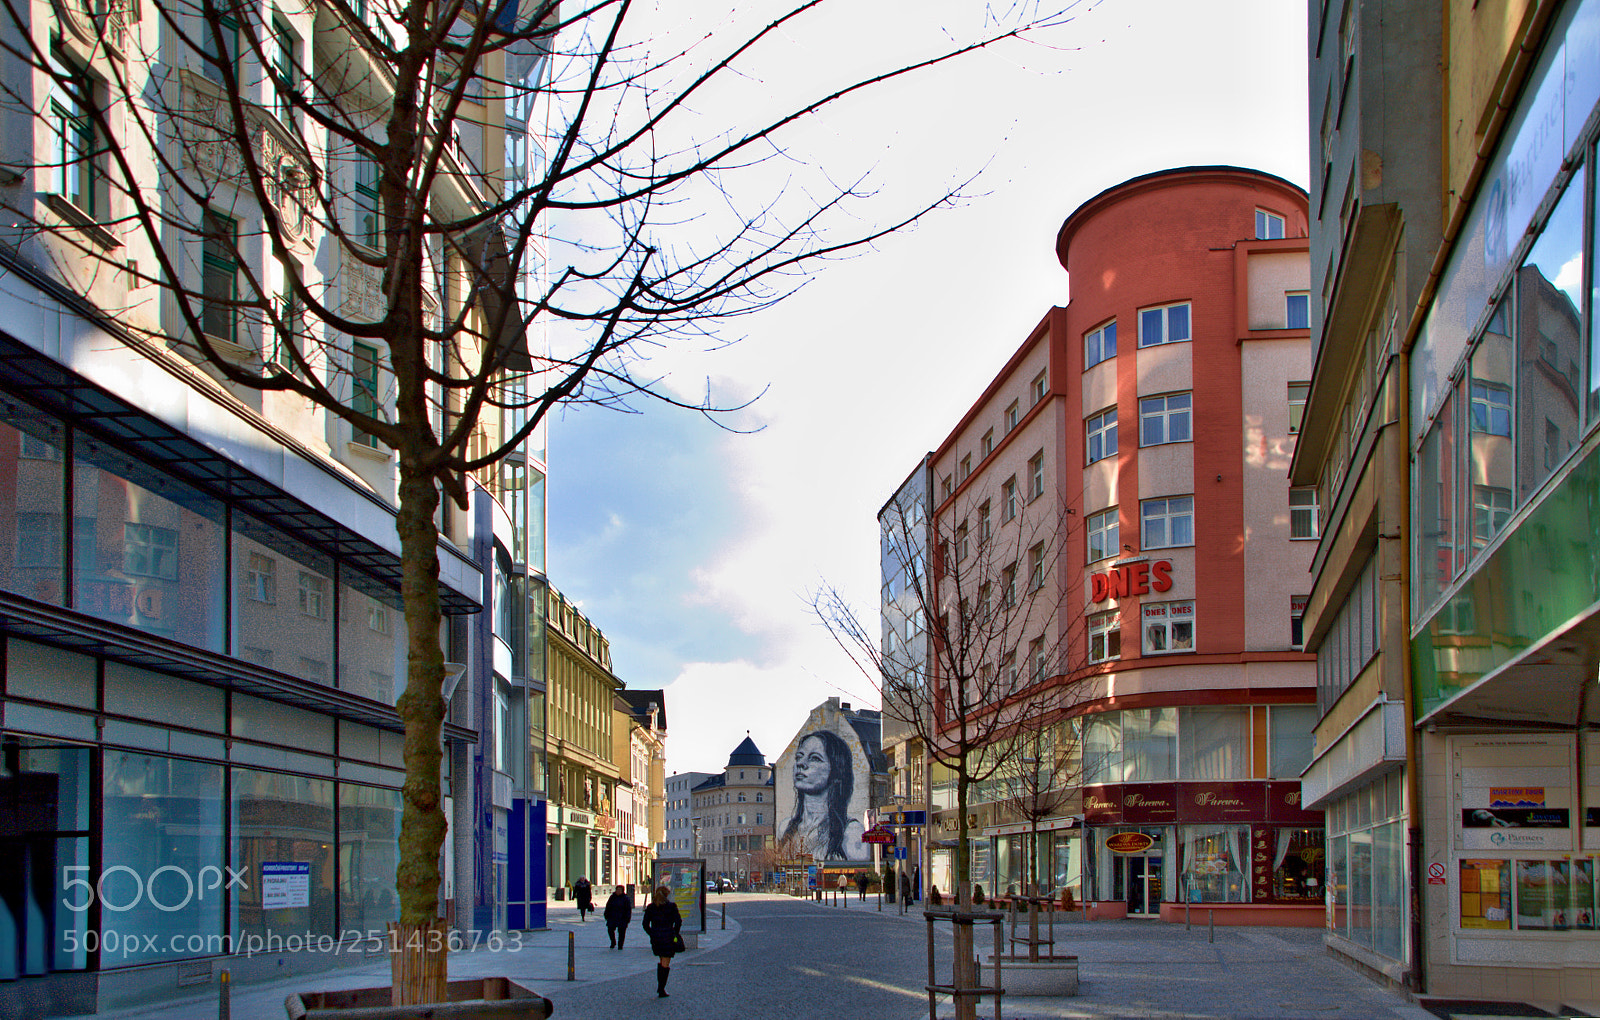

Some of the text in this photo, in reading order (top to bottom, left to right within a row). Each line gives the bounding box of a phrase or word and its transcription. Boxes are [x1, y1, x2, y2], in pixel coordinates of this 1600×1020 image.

[1091, 561, 1173, 603] DNES
[1145, 608, 1166, 617] DNES
[1171, 606, 1192, 615] DNES
[1508, 833, 1544, 841] Partners
